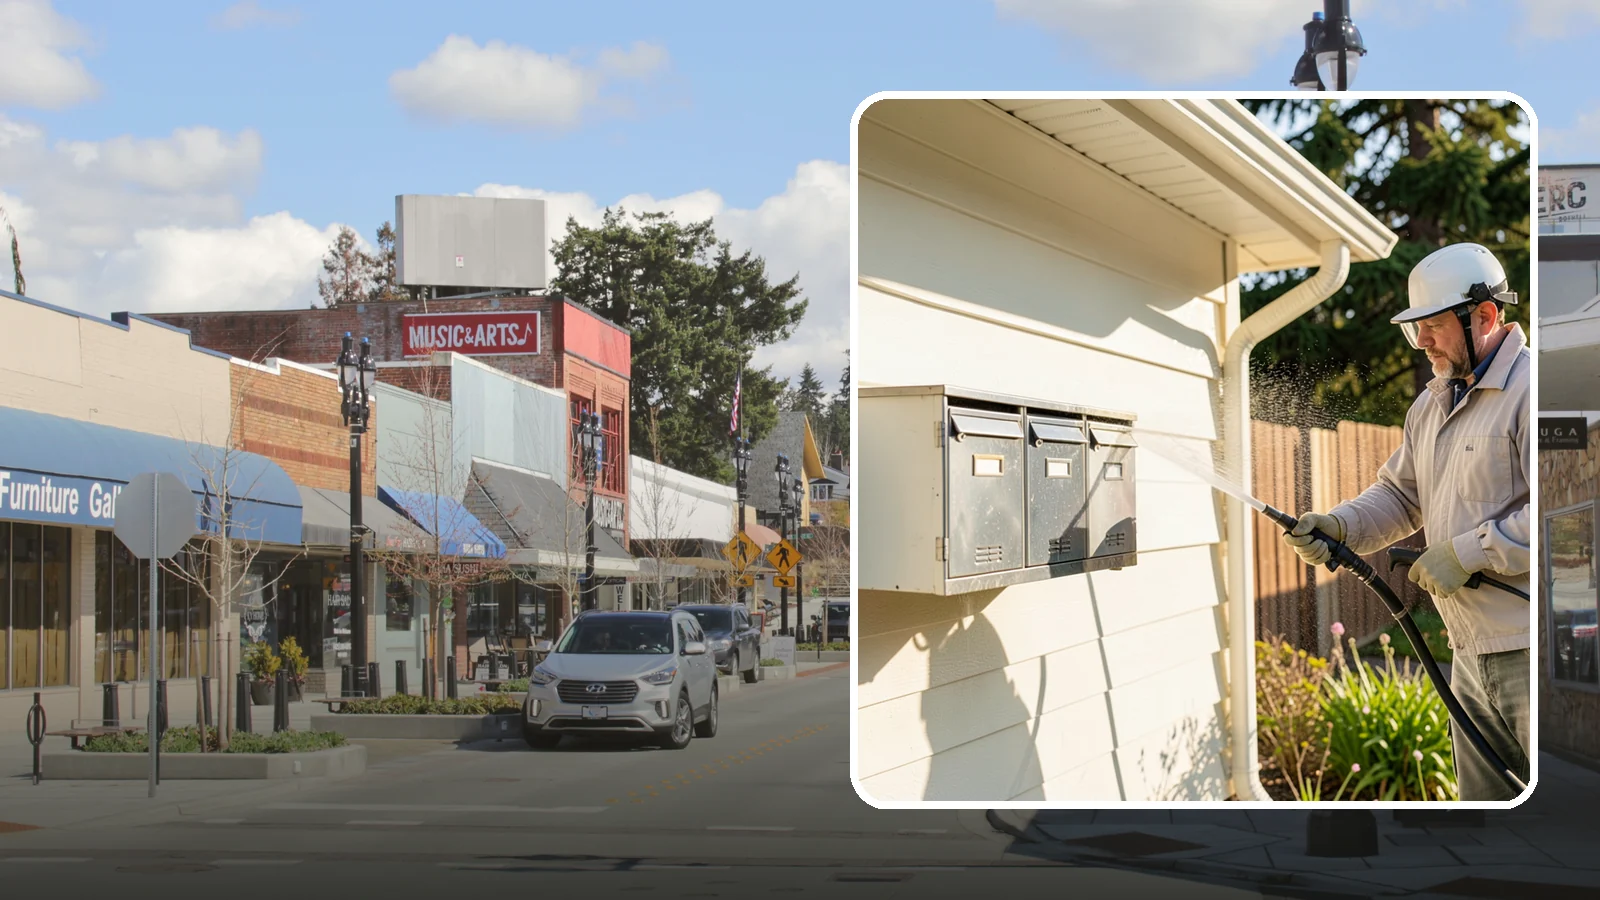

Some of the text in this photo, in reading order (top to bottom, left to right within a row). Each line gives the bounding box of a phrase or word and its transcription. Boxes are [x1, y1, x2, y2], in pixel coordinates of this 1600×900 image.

[409, 322, 519, 349] MUSIC&ARTS
[0, 471, 122, 519] Furniture Gal
[453, 563, 479, 574] SUSHI
